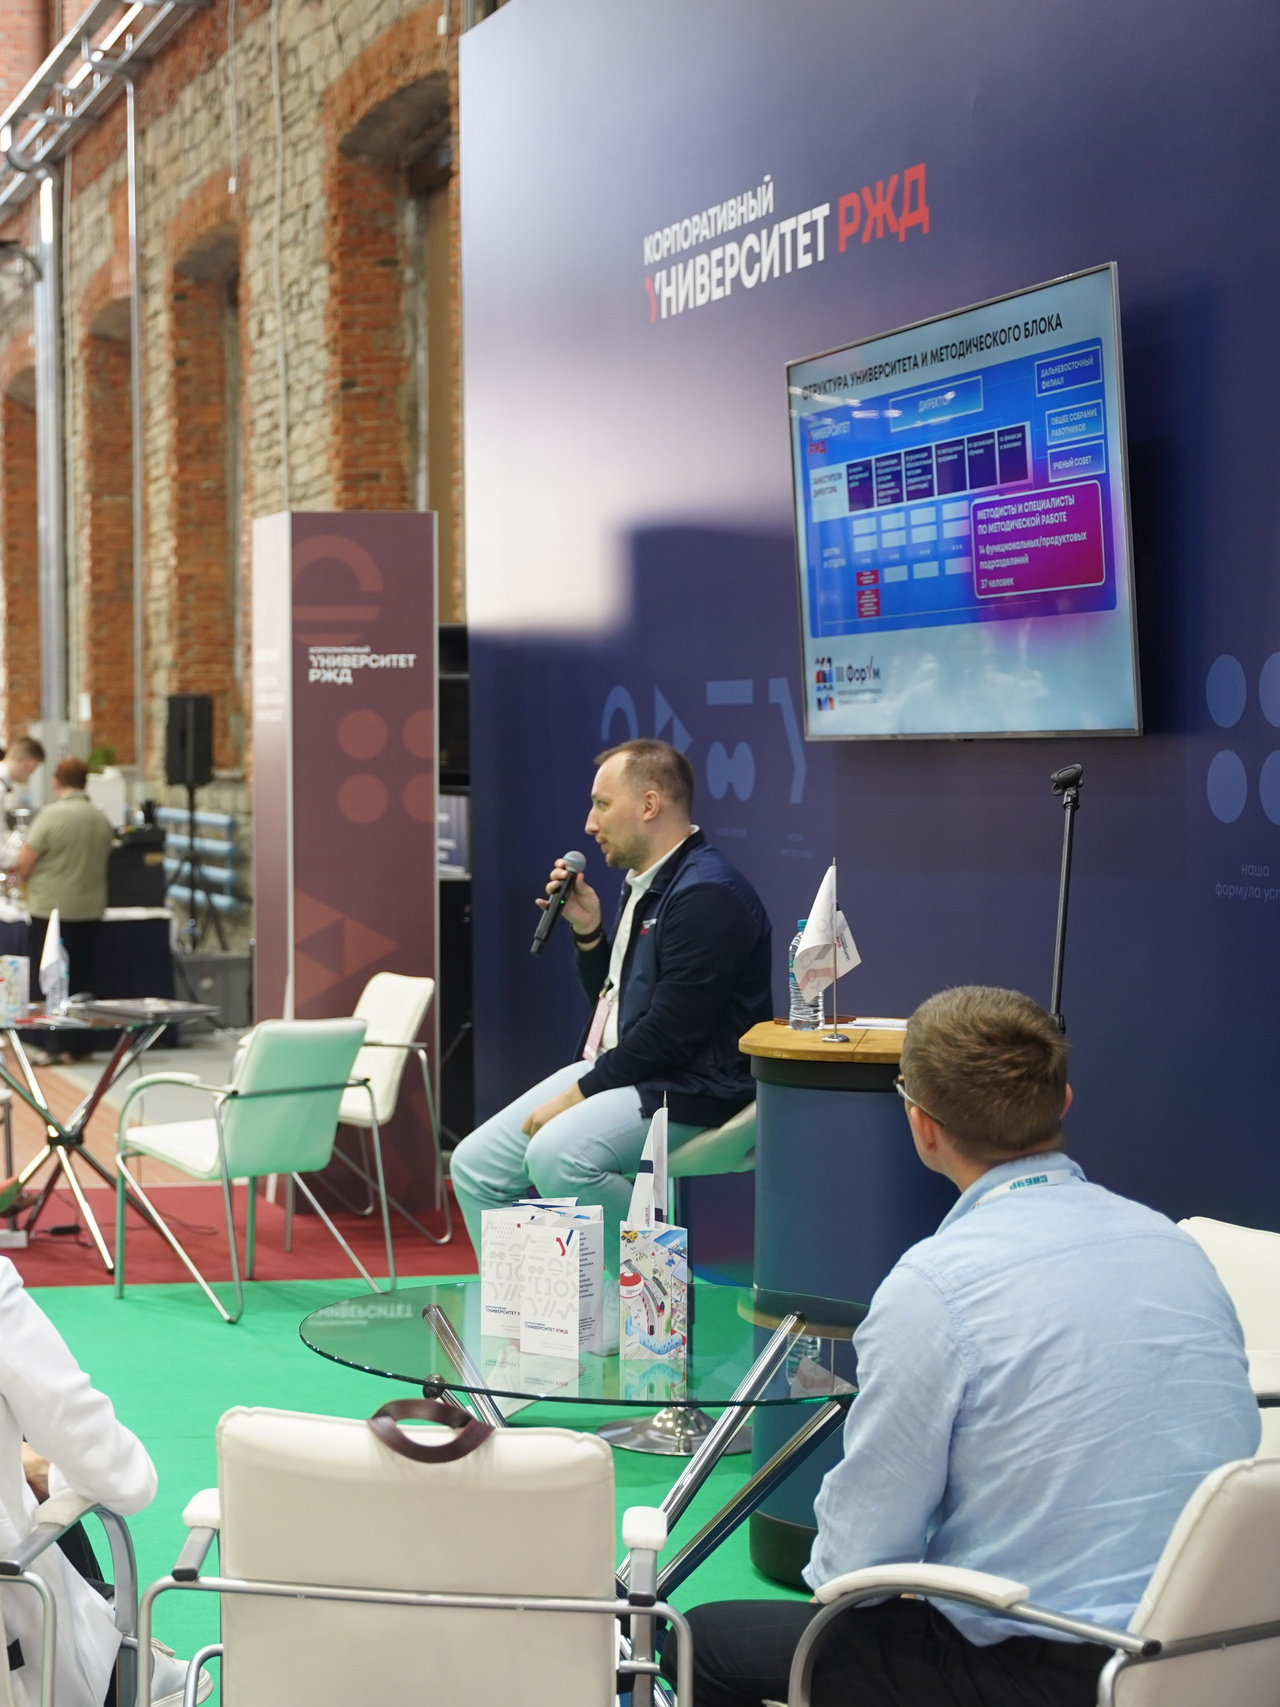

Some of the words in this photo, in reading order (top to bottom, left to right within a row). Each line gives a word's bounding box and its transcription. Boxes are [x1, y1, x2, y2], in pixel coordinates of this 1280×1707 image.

[644, 174, 774, 265] КОРПОРАТИВНЫЙ
[644, 202, 830, 323] УНИВЕРСИТЕТ
[838, 162, 930, 253] РЖД
[802, 374, 849, 400] СТРУКТУРА
[849, 354, 919, 387] УНИВЕРСИТЕТА
[920, 351, 929, 367] И
[930, 324, 1021, 365] МЕТОДИЧЕСКОГО
[1024, 312, 1063, 339] БЛОКА
[1040, 354, 1094, 378] ДАЛЬНЕВОСТОЧНЫЙ
[1051, 414, 1069, 426] ОБЩЕЕ
[1069, 408, 1098, 422] СОБРАНИЕ
[977, 504, 1018, 520] МЕТОДИСТЫ
[1018, 503, 1023, 513] И
[1023, 494, 1075, 513] СПЕЦИАЛИСТЫ
[978, 524, 987, 535] ПО
[988, 513, 1040, 534] МЕТОДИЧЕСКОЙ
[1041, 512, 1067, 525] РАБОТЕ
[308, 653, 417, 668] УНИВЕРСИТЕТ
[308, 668, 353, 685] РЖД
[1241, 864, 1270, 877] наша
[1215, 882, 1261, 901] формула
